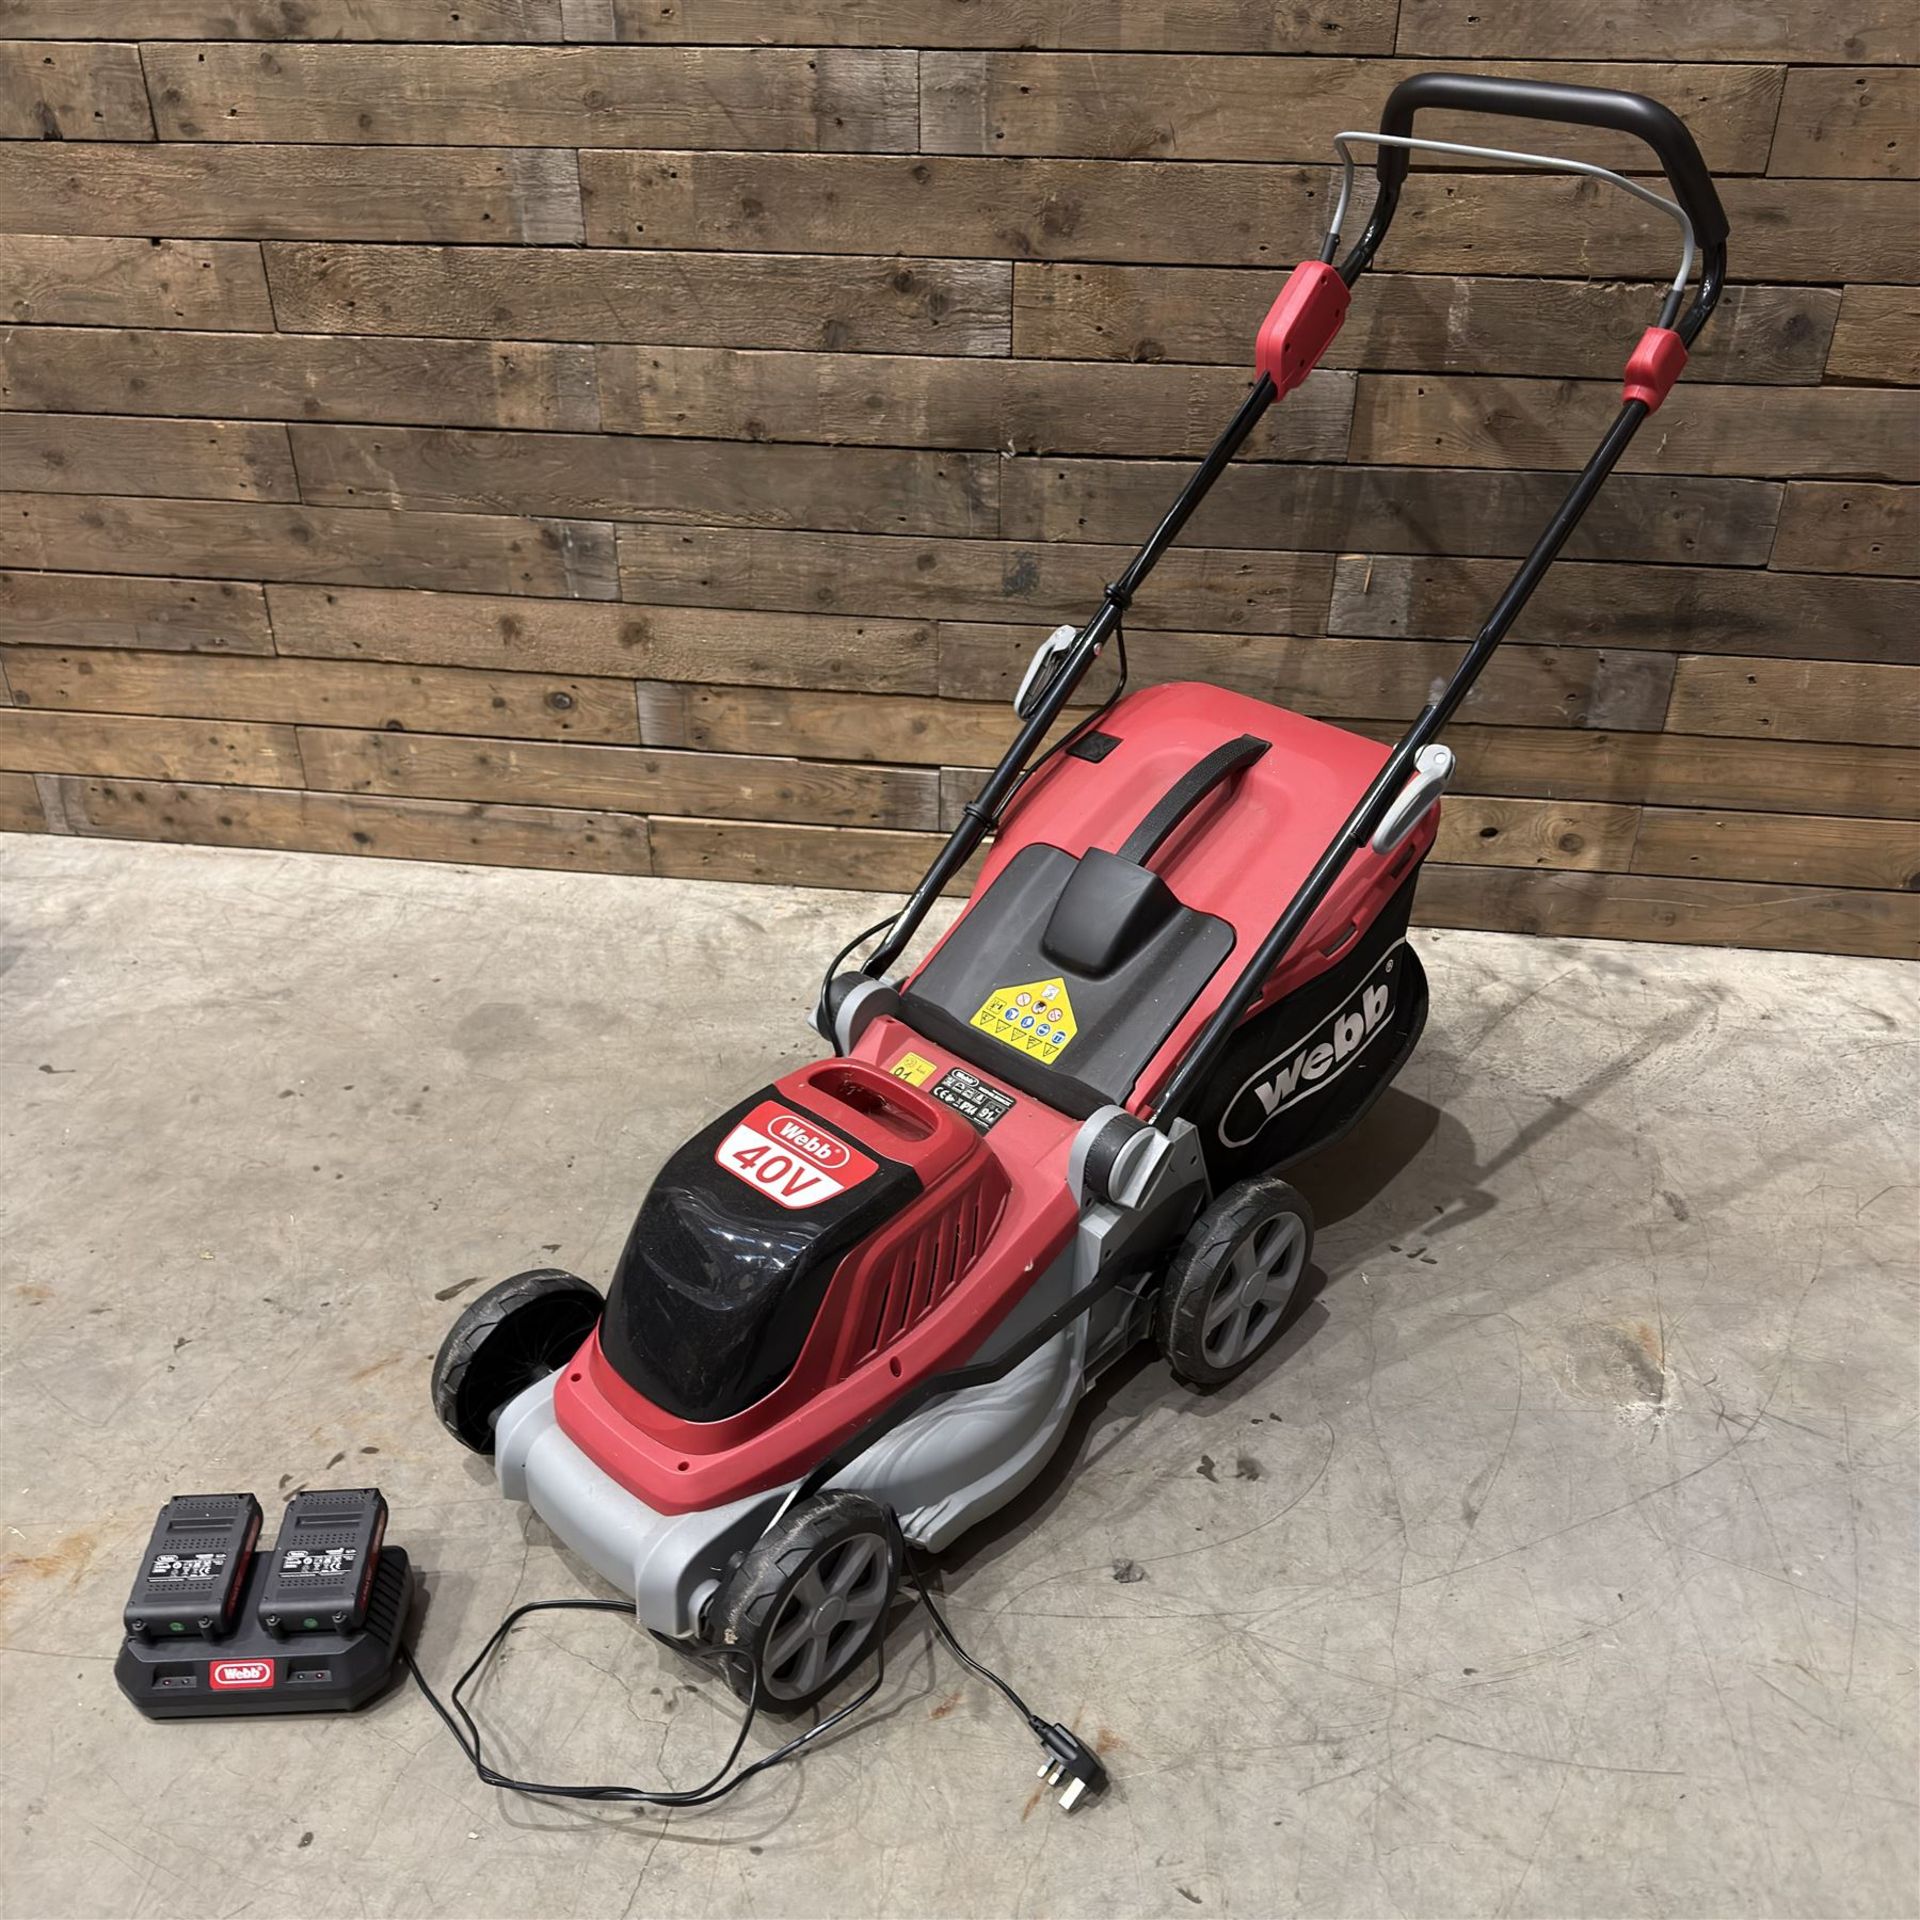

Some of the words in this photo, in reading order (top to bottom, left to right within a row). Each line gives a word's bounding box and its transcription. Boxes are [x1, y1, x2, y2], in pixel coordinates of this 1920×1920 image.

[1254, 984, 1388, 1115] Webb
[779, 1121, 832, 1159] Webb
[732, 1145, 822, 1197] 40V
[224, 1667, 260, 1679] Webb
